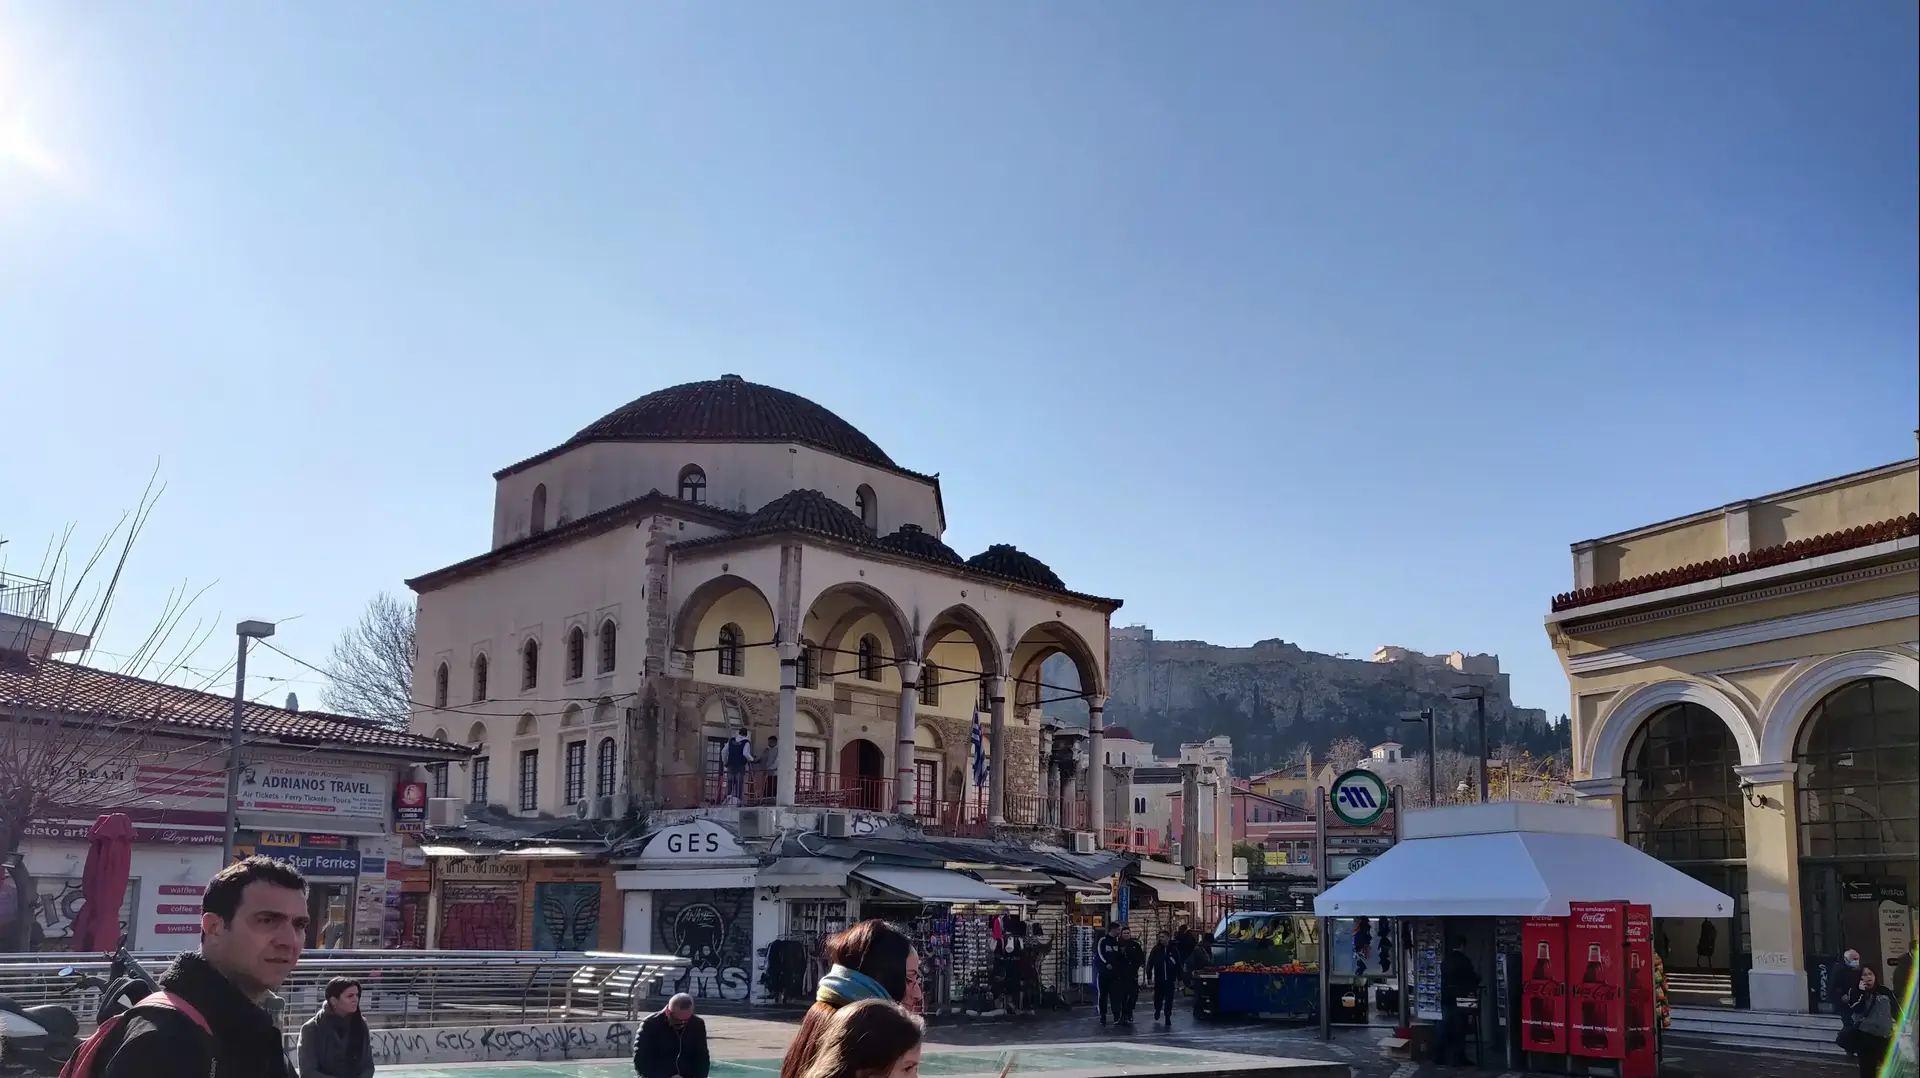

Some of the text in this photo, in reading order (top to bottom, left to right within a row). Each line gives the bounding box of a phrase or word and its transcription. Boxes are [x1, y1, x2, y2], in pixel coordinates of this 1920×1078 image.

[262, 775, 371, 795] ADRIANOS TRAVEL
[255, 791, 279, 799] Tickets
[285, 793, 302, 802] Ferry
[333, 796, 352, 804] Tours
[399, 823, 421, 831] ATM
[191, 834, 224, 844] waffles
[266, 832, 296, 844] ATM
[667, 832, 719, 853] GES
[288, 854, 314, 869] Star
[315, 855, 357, 870] Ferries
[473, 862, 487, 874] old
[490, 863, 522, 876] mosque
